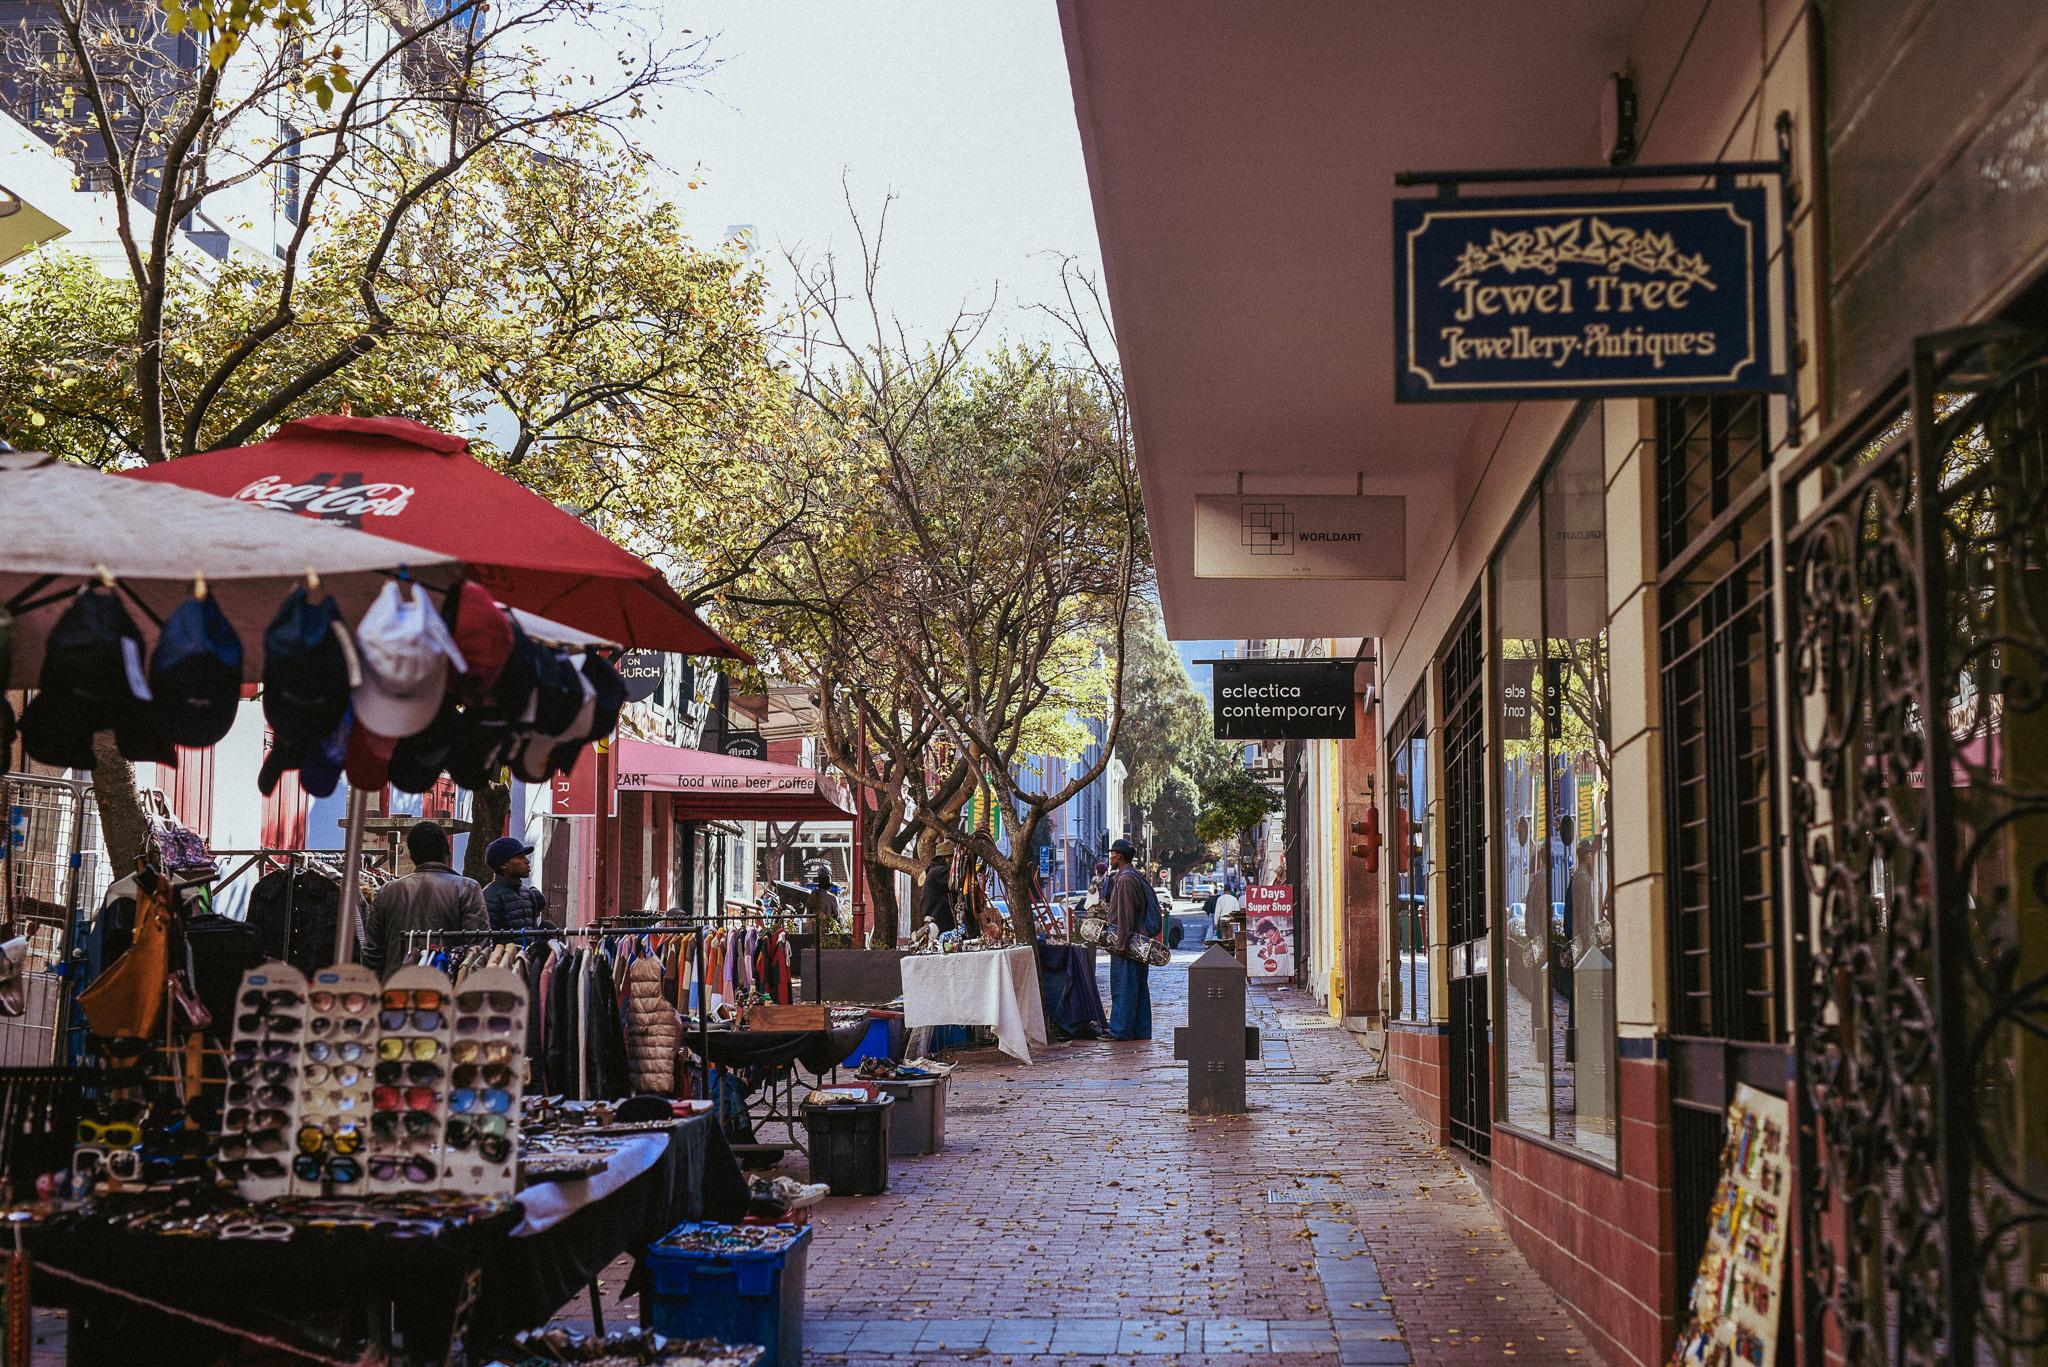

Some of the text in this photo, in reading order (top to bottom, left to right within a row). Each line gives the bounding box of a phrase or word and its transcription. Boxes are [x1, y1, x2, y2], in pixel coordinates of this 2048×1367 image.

[1453, 276, 1692, 322] Jewel Tree
[1299, 532, 1363, 542] WORLDART
[627, 658, 641, 666] ON
[619, 667, 661, 678] HURCH
[1222, 683, 1301, 698] eclectica
[1222, 702, 1347, 721] contemporary
[678, 775, 705, 787] food
[711, 776, 739, 788] wine
[745, 776, 772, 788] beer
[778, 776, 814, 790] coffee
[1251, 887, 1286, 901] 7 Days
[1247, 902, 1292, 914] Super Shop
